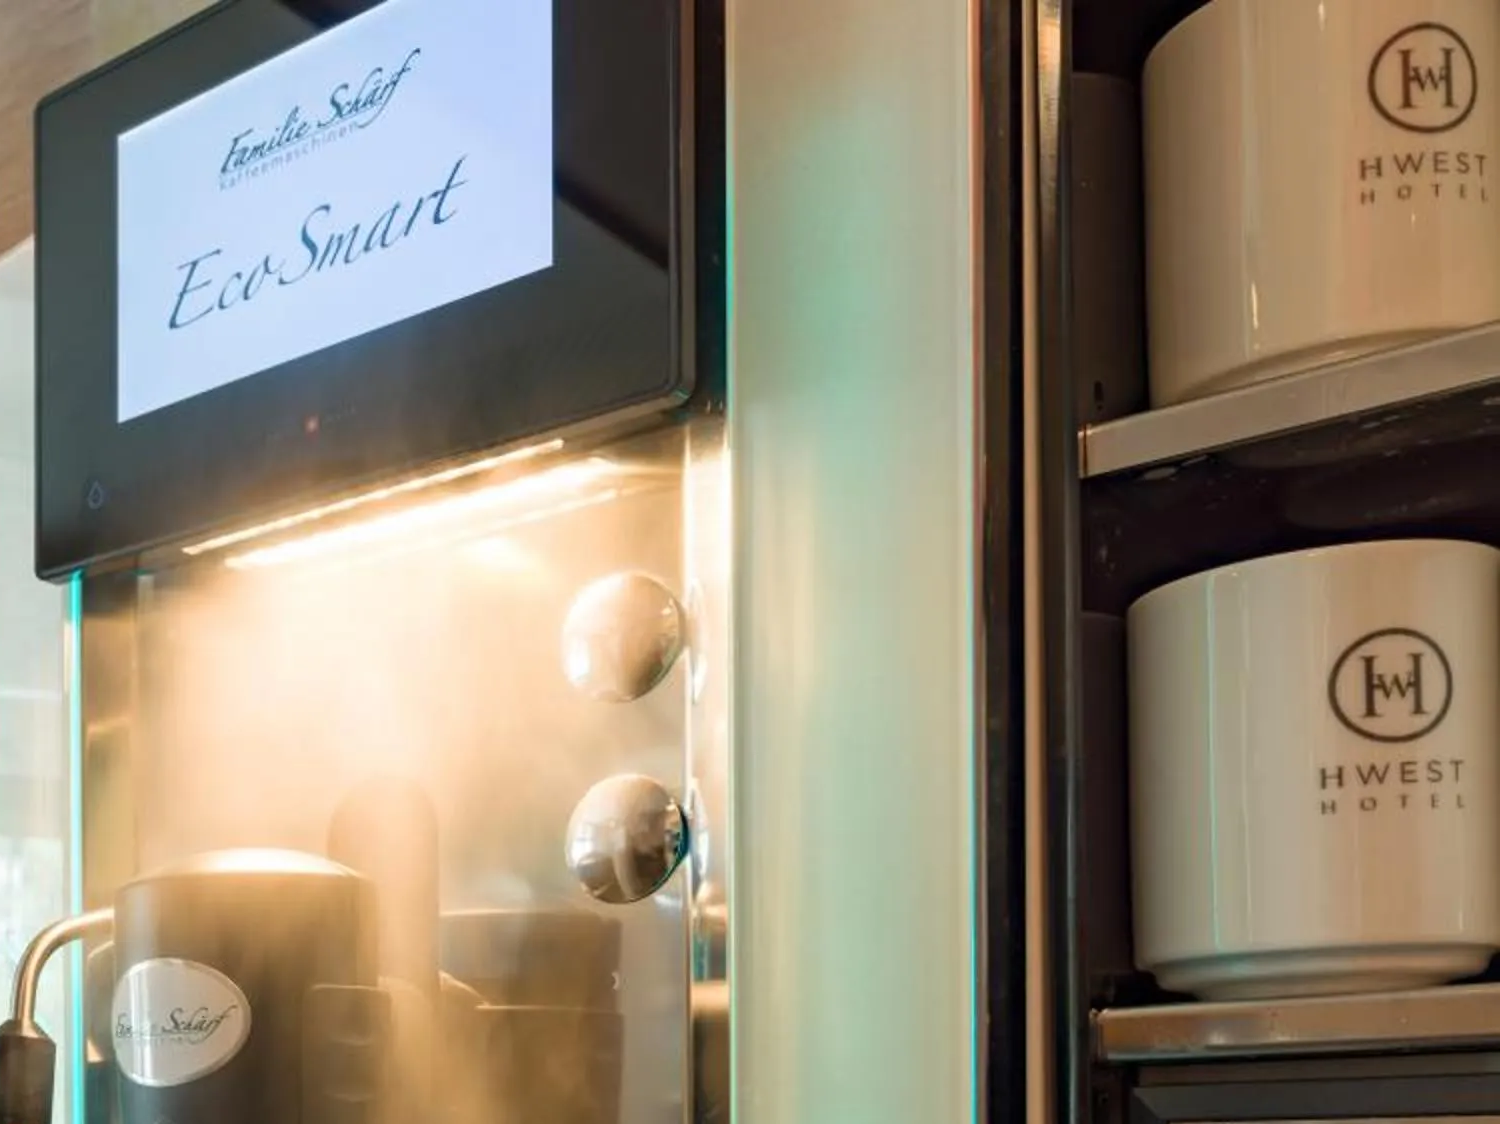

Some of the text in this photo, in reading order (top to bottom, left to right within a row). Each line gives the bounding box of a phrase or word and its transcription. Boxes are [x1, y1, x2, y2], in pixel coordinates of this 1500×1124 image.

[220, 47, 421, 174] Familie Schärf
[1359, 151, 1487, 181] HWEST
[1360, 183, 1489, 205] HOTEL
[168, 153, 470, 330] EcoSmart
[1320, 758, 1464, 790] HWEST
[1320, 793, 1465, 815] HOTEL
